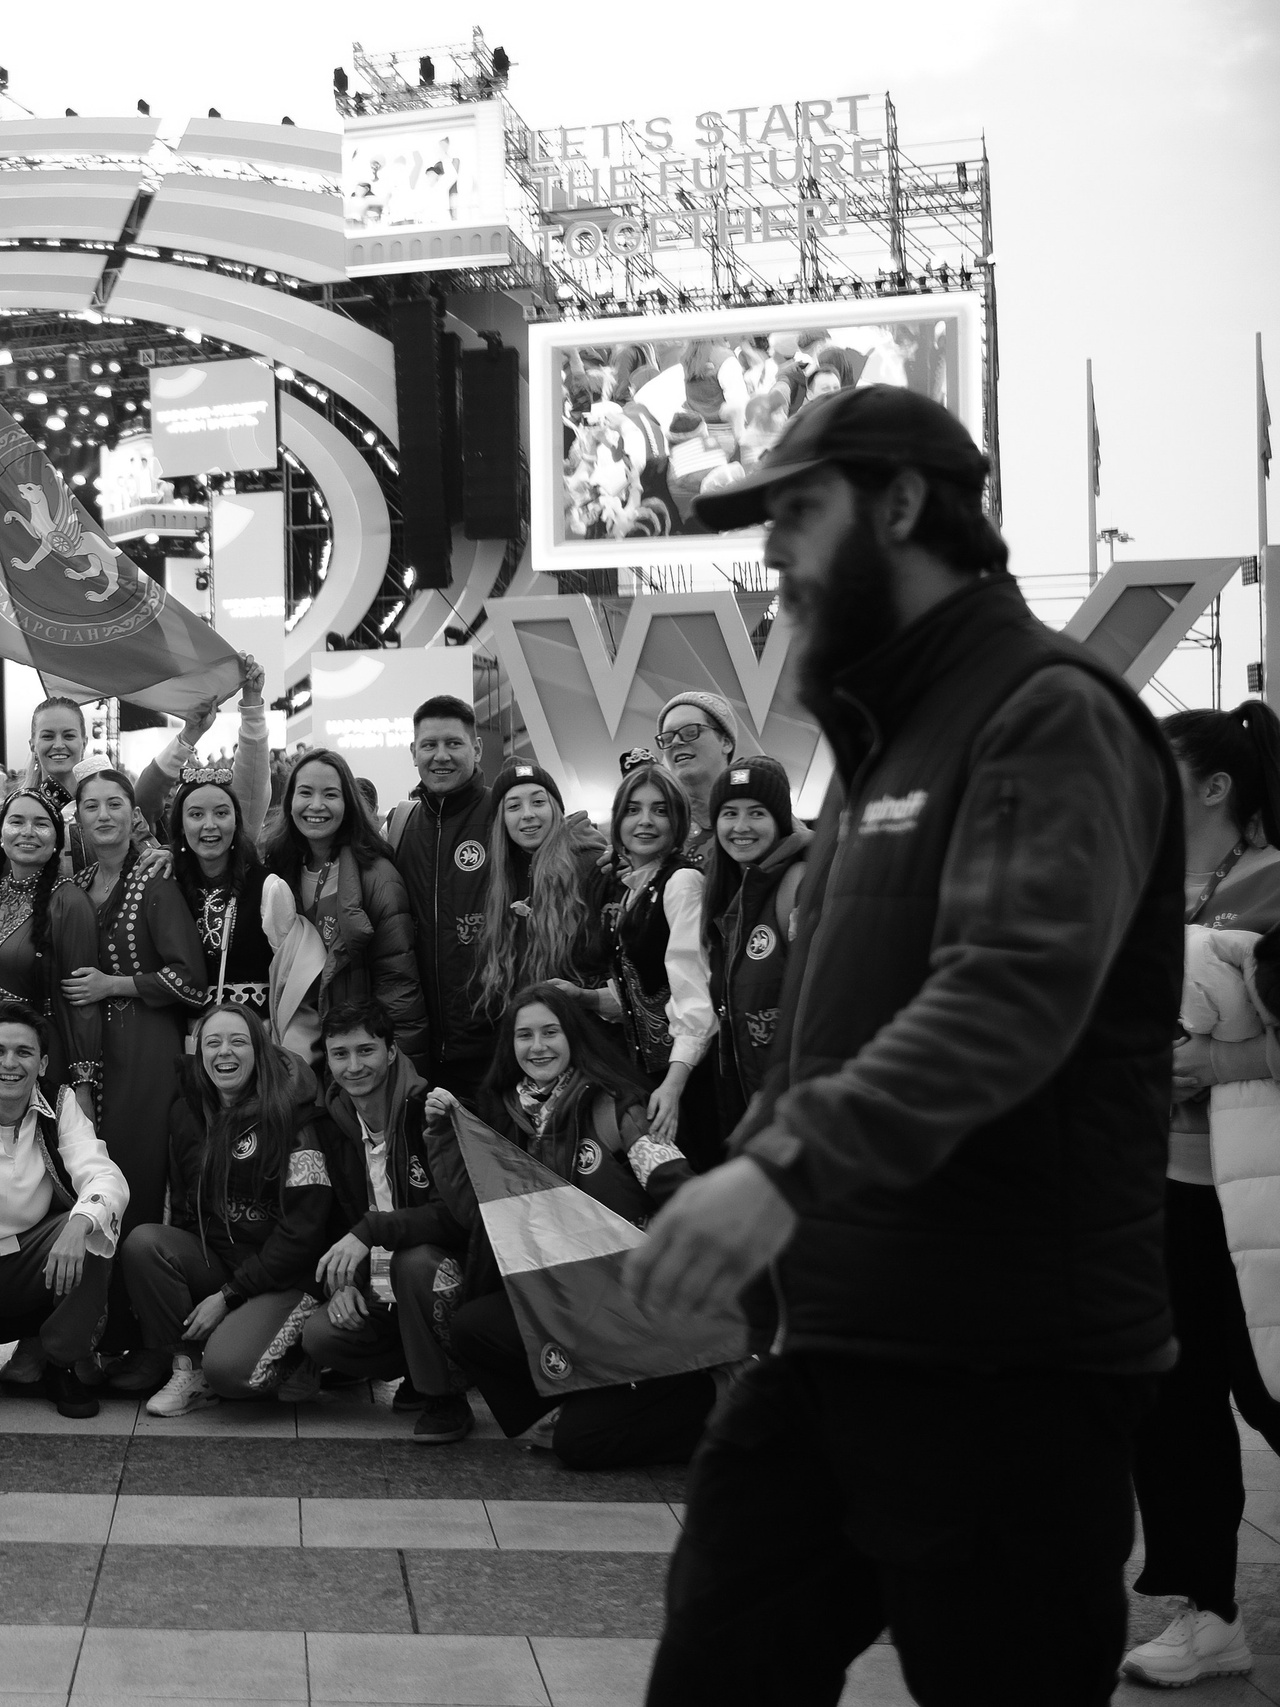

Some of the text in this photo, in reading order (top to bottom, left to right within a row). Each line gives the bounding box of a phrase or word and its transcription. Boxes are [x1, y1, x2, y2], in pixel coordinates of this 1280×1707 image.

[531, 95, 869, 161] LET'S START
[531, 138, 884, 211] THE FUTURE
[537, 197, 848, 264] TOGETHER!
